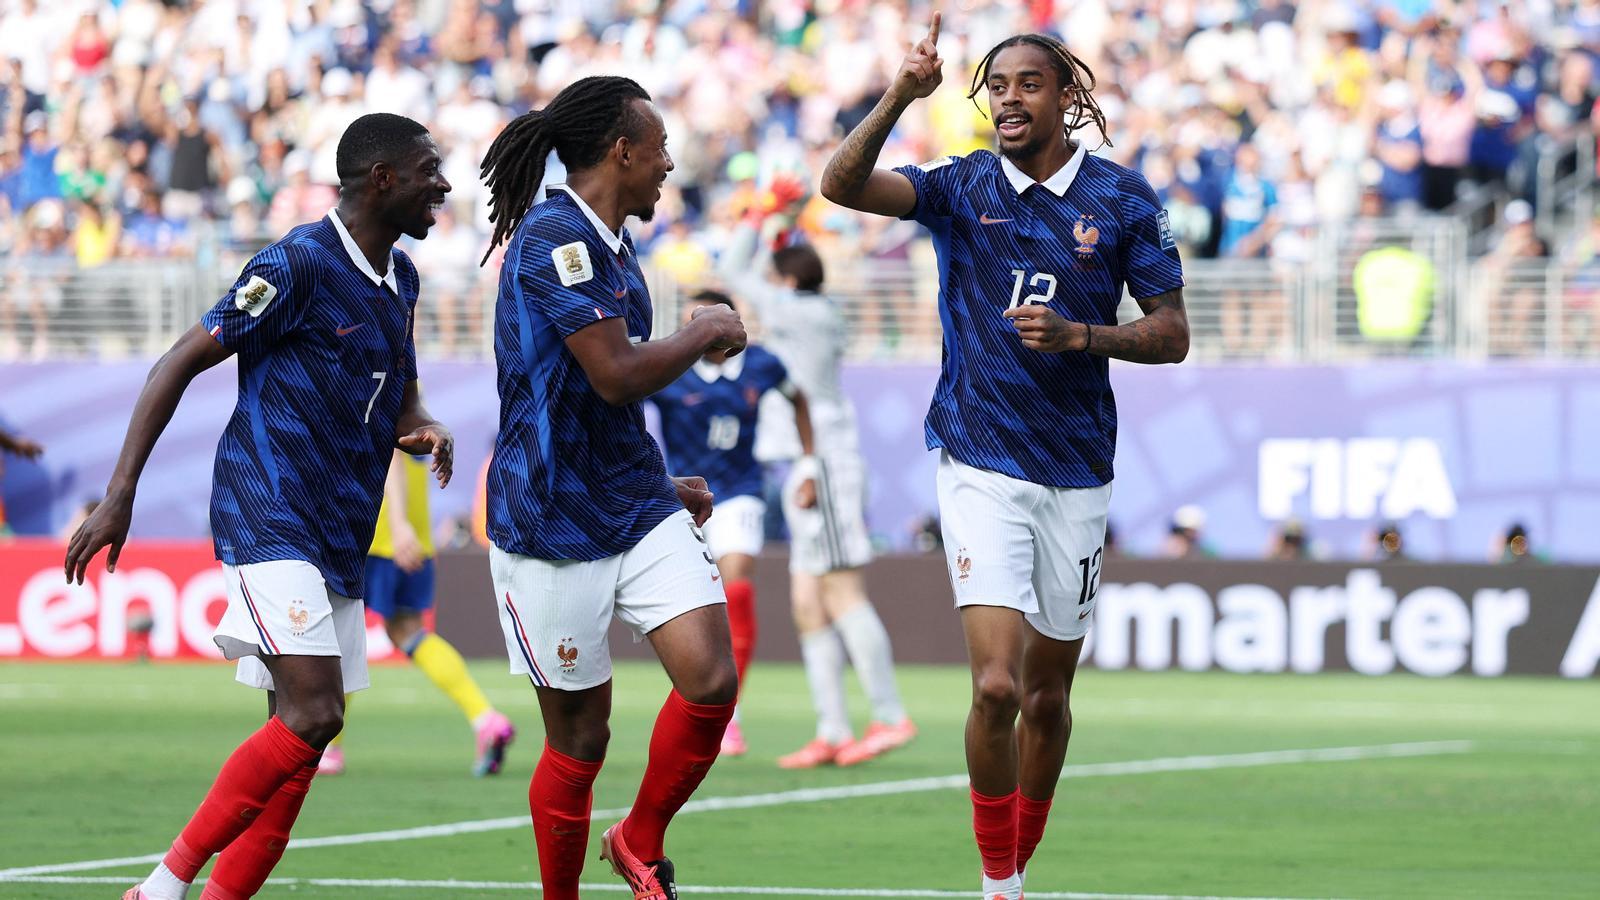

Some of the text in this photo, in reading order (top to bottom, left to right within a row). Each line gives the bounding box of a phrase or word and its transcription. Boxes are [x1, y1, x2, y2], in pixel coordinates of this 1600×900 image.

[1007, 269, 1057, 320] 12
[364, 371, 387, 424] 7
[1258, 437, 1458, 520] FIFA
[1079, 546, 1102, 606] 12
[1079, 568, 1531, 678] marter
